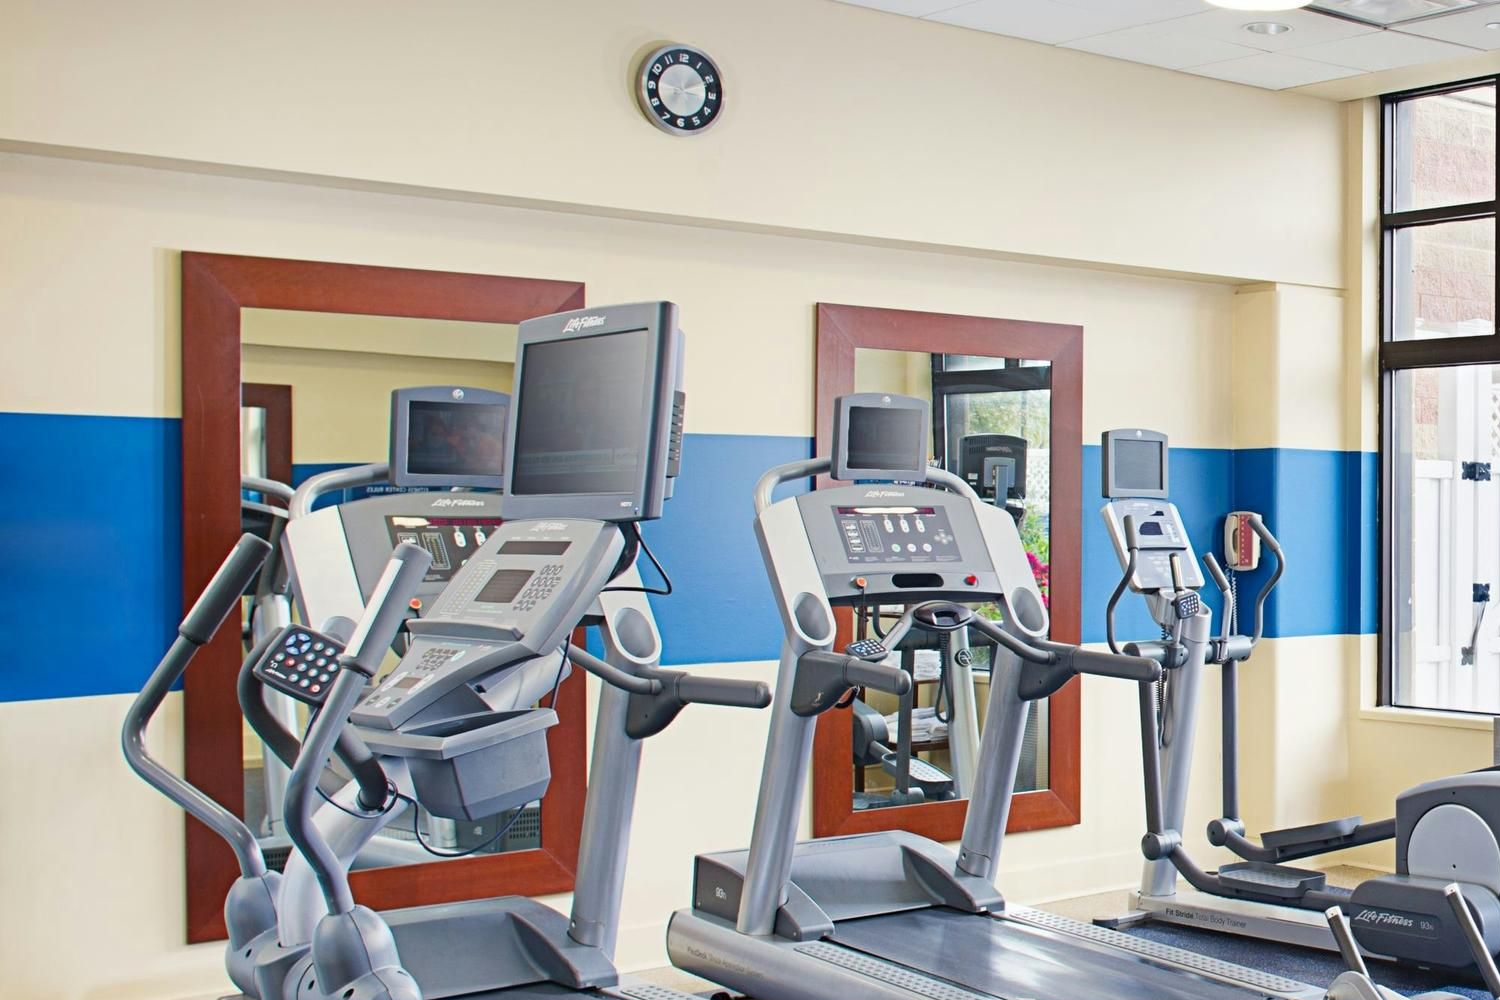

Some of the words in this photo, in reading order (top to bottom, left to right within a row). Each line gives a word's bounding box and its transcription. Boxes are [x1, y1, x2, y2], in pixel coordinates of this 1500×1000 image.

[664, 55, 673, 64] 11
[679, 53, 689, 63] 12
[652, 64, 662, 75] 10
[705, 75, 713, 83] 2
[648, 81, 656, 89] 9
[708, 92, 716, 100] 3
[651, 98, 659, 106] 8
[704, 106, 711, 115] 4
[662, 112, 671, 120] 7
[692, 116, 700, 125] 5
[677, 118, 685, 127] 6
[1165, 907, 1174, 916] Fit
[1175, 909, 1194, 920] Stride
[1195, 913, 1209, 922] Total
[1210, 915, 1225, 926] Body
[1226, 918, 1248, 929] Trainer
[1354, 909, 1377, 924] Life
[1376, 911, 1414, 928] Fitness
